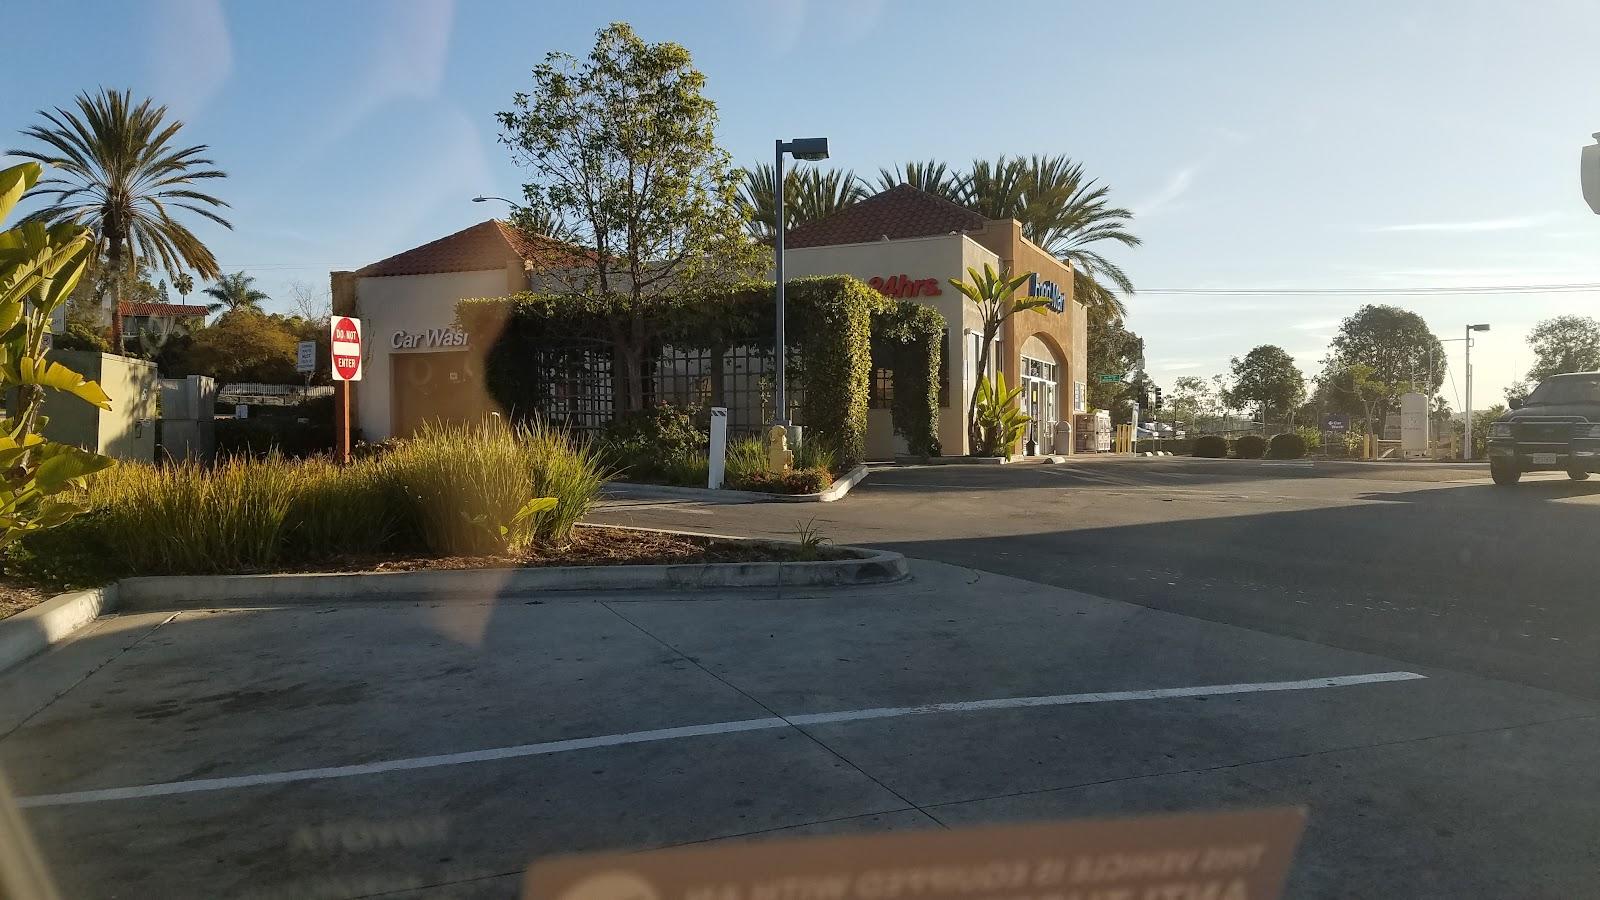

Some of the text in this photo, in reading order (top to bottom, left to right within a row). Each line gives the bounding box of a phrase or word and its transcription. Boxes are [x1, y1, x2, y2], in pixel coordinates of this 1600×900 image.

[336, 329, 357, 340] DO NOT
[391, 330, 424, 349] Car
[338, 358, 356, 368] ENTER
